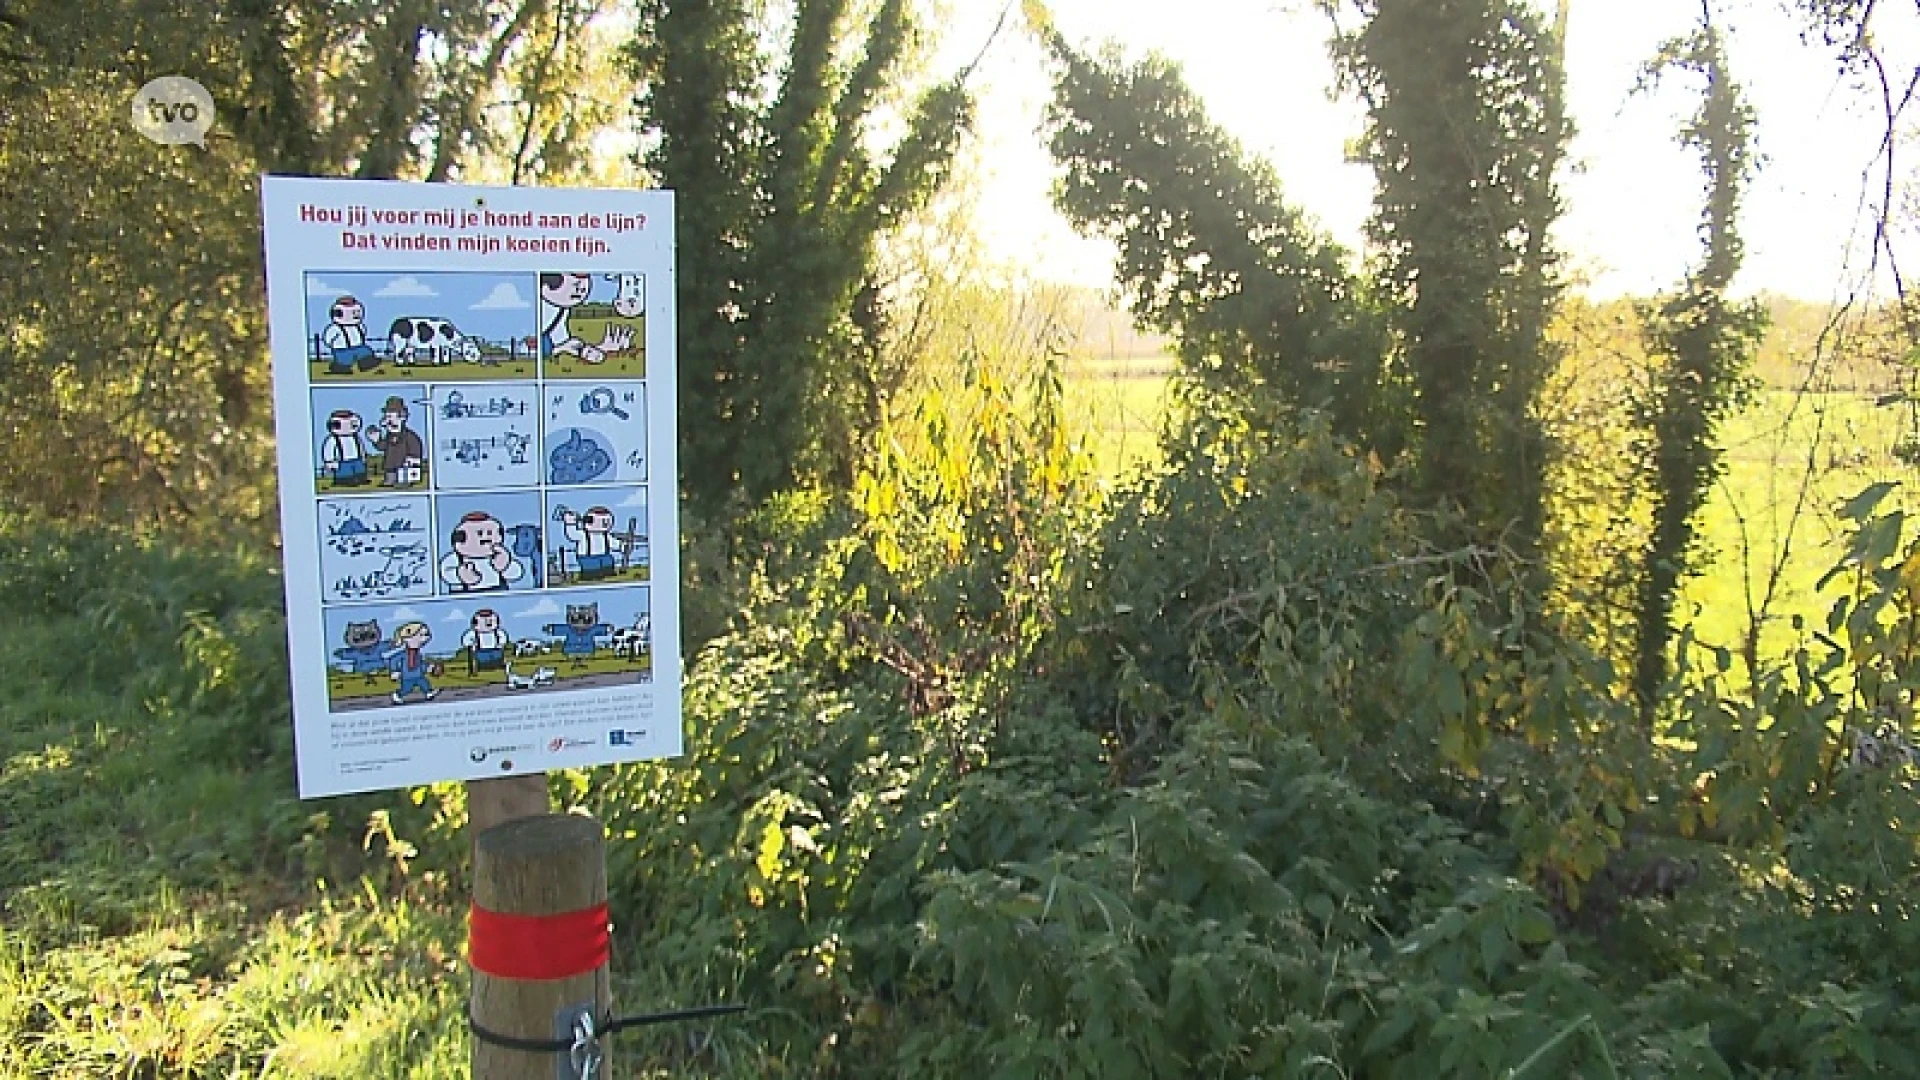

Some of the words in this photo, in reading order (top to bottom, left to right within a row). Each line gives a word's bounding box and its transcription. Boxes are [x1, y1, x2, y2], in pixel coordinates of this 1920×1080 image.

[300, 203, 342, 223] Hou
[347, 206, 367, 227] jij
[372, 208, 419, 226] voor
[423, 208, 456, 228] mij
[460, 208, 479, 229] je
[484, 210, 533, 228] hond
[537, 214, 572, 229] aan
[577, 212, 601, 230] de
[606, 213, 647, 233] lijn?
[341, 232, 377, 249] Dat
[381, 232, 451, 251] vinden
[456, 234, 500, 254] mijn
[505, 235, 570, 252] koeien
[575, 237, 612, 257] fijn.
